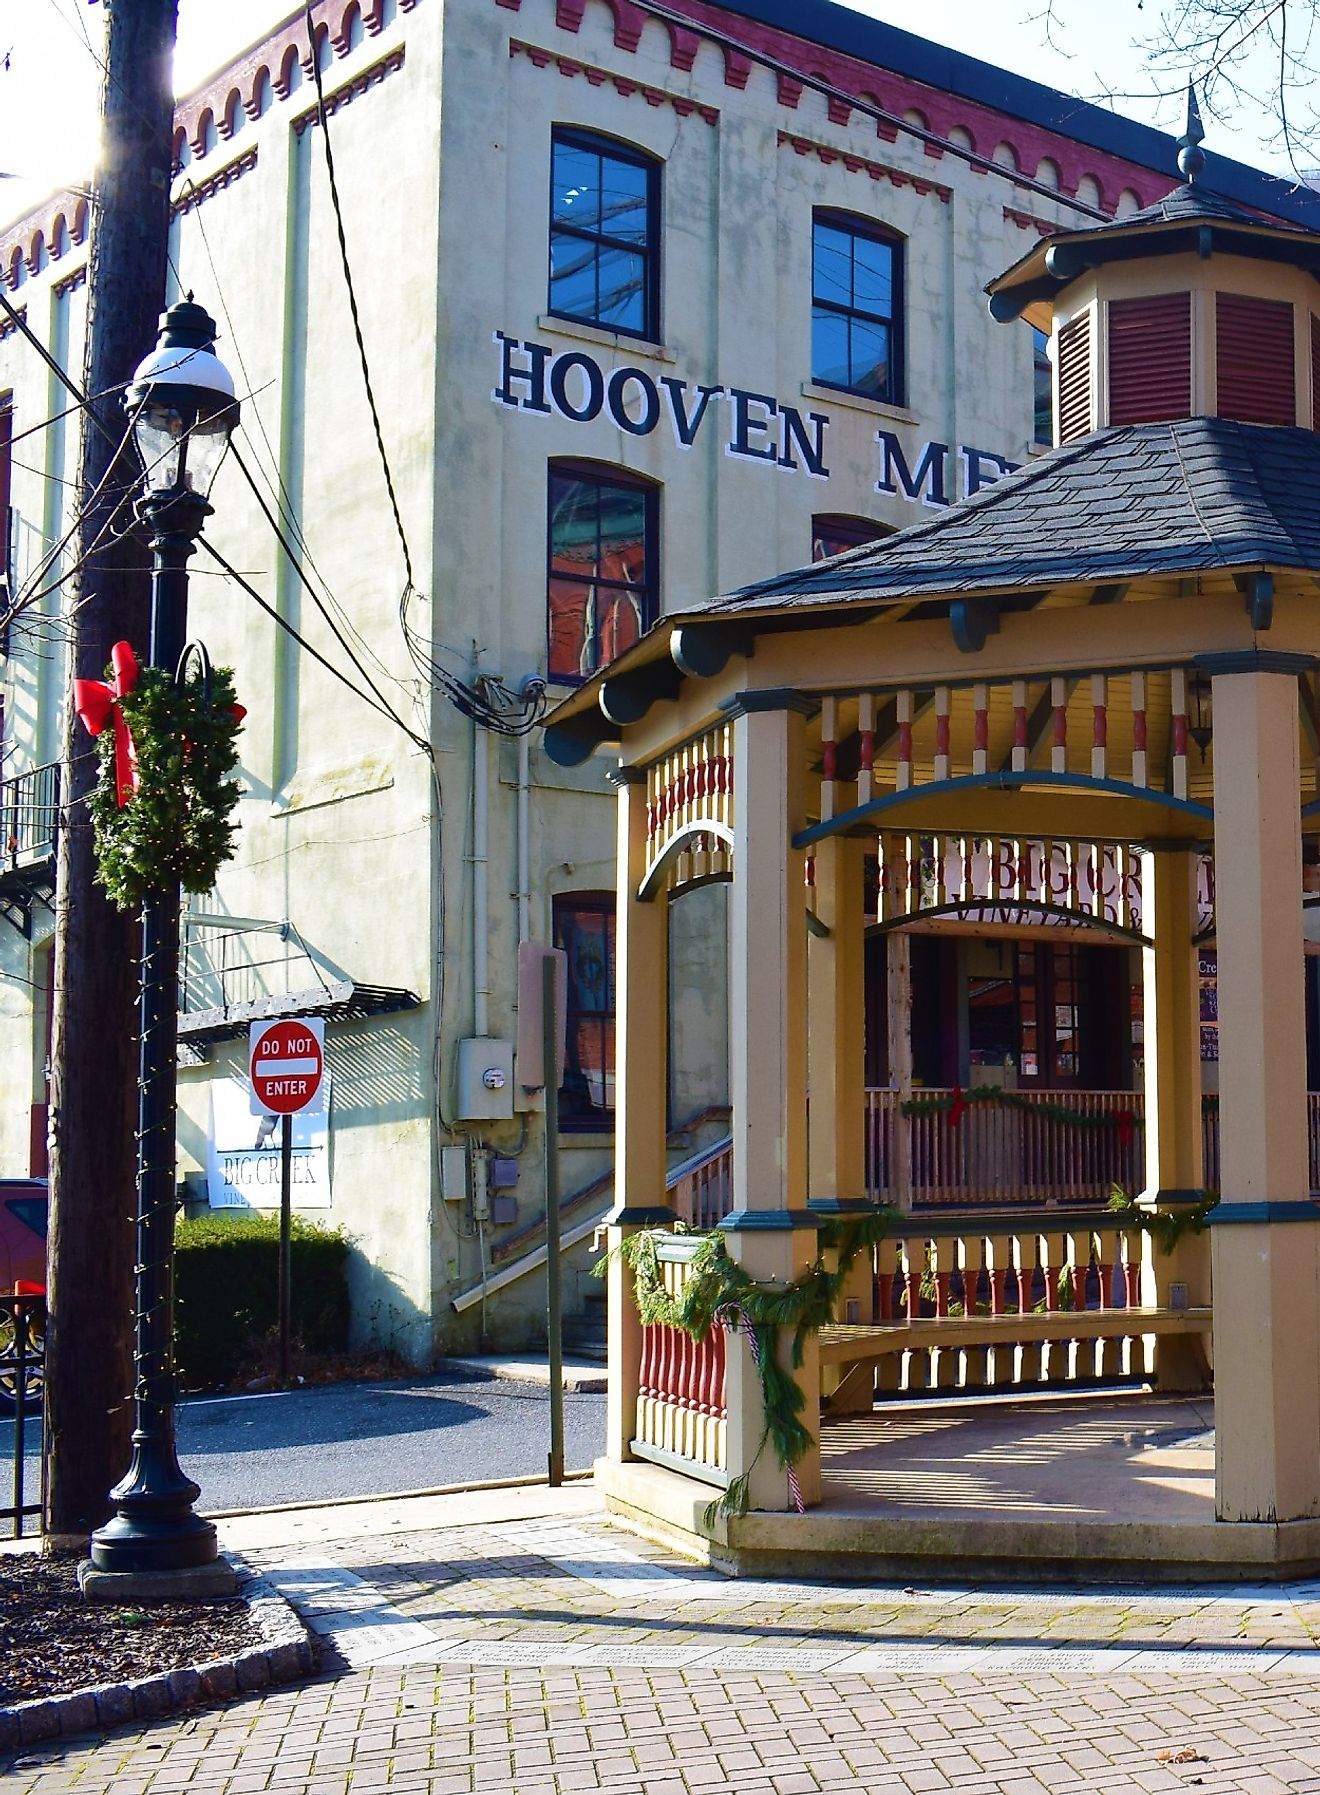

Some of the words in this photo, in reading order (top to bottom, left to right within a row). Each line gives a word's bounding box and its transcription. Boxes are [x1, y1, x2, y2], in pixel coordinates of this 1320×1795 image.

[492, 330, 830, 480] HOOVEN
[874, 430, 1021, 508] ME
[1199, 960, 1217, 974] Cre
[262, 1040, 280, 1055] DO
[287, 1038, 313, 1054] NOT
[266, 1080, 307, 1096] ENTER
[224, 1157, 252, 1186] BIG
[256, 1155, 318, 1185] CREK
